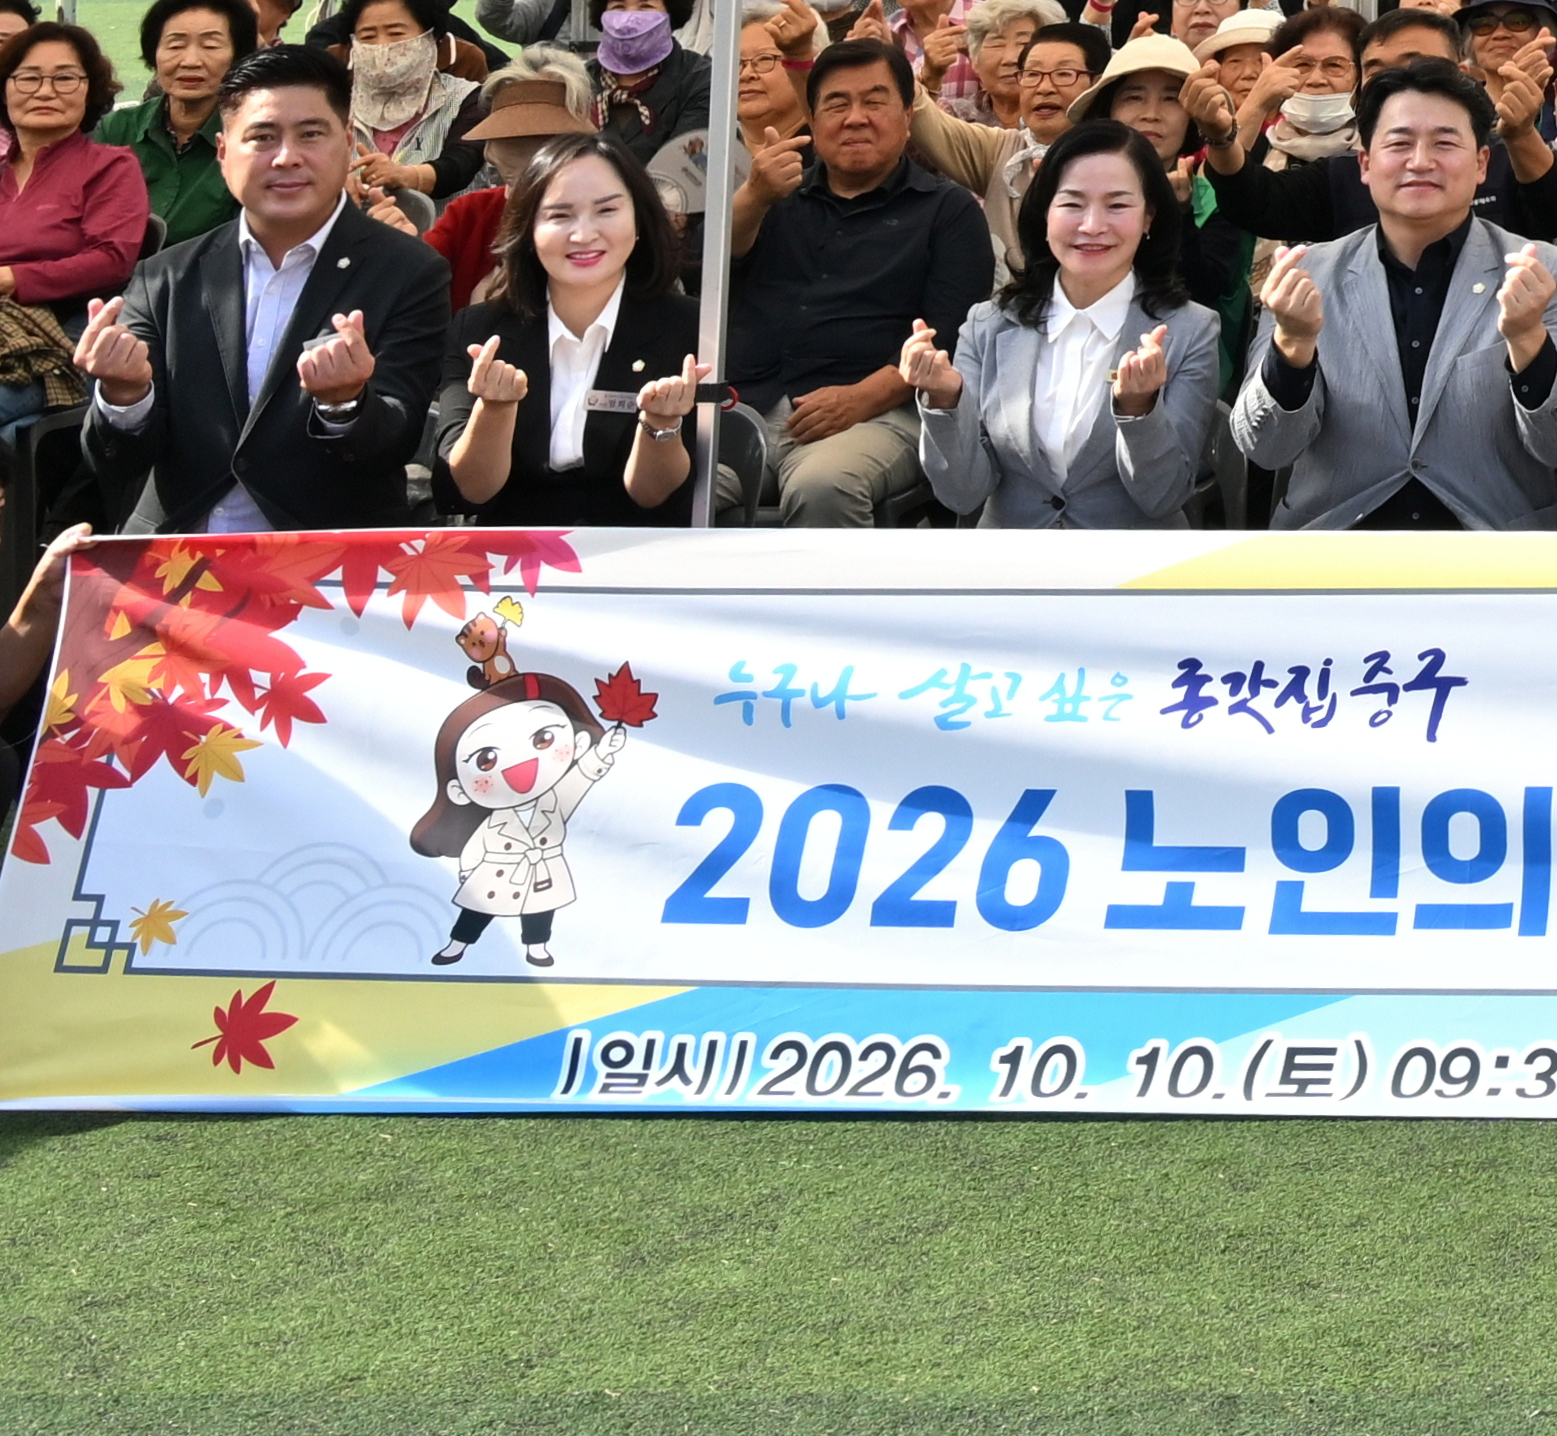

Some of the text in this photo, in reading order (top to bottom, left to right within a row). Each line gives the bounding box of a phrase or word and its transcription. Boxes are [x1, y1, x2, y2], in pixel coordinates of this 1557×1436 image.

[714, 660, 876, 729] 누구나
[899, 661, 1023, 731] 살고
[1039, 666, 1134, 725] 싶은
[1349, 647, 1468, 742] 중구
[661, 782, 1071, 932] 2026
[757, 1040, 957, 1101] 2026.
[997, 1043, 1089, 1101] 10.
